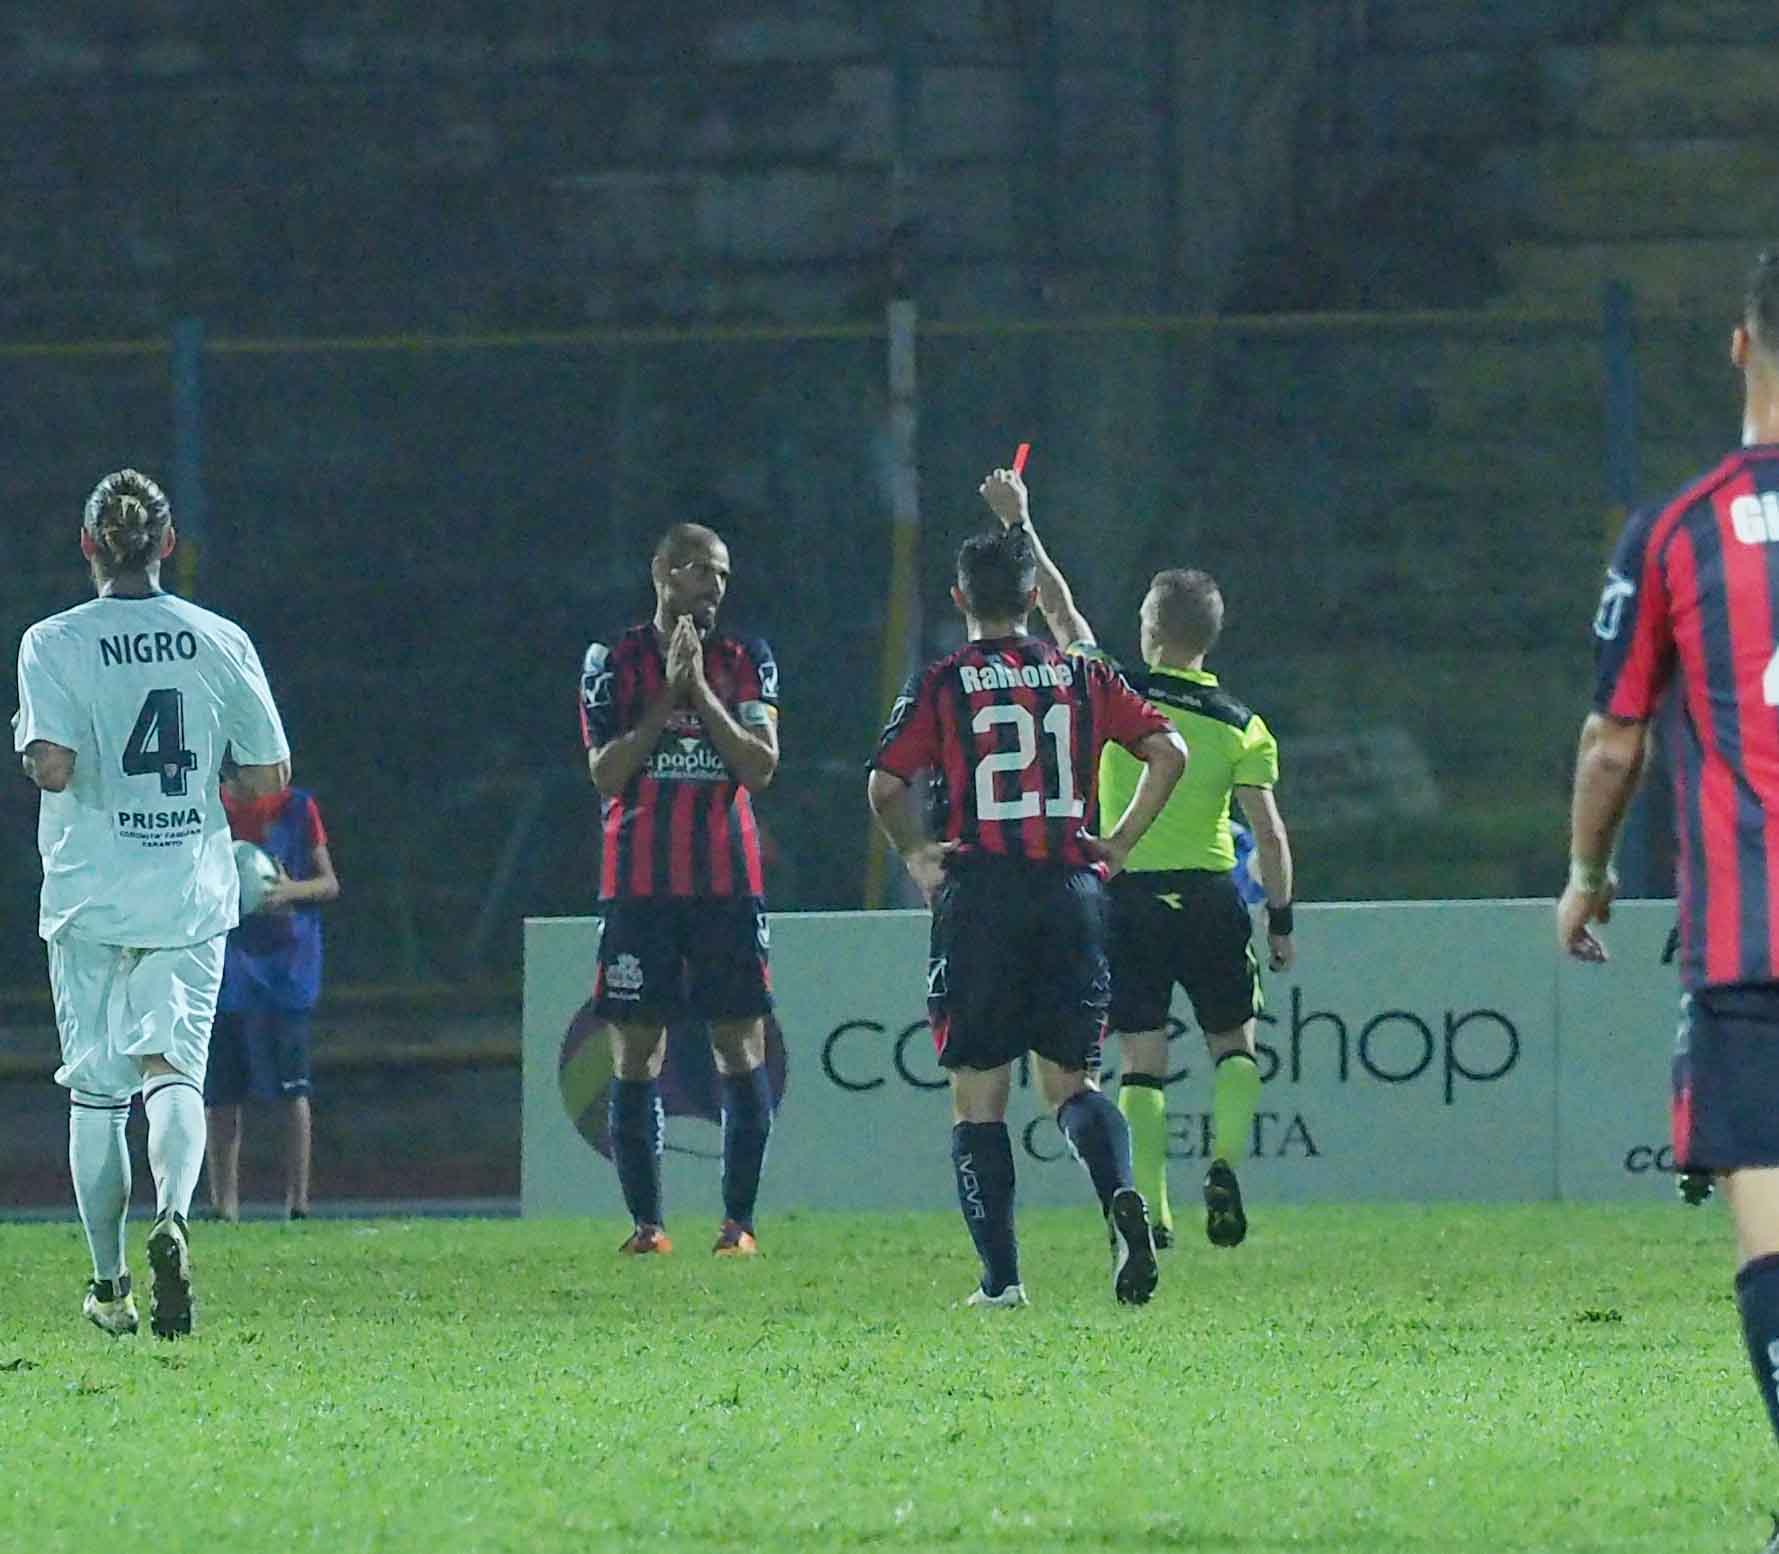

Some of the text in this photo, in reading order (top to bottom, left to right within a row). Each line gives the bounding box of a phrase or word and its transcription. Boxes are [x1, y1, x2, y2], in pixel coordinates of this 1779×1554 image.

[100, 631, 198, 666] NIGRO
[122, 688, 198, 797] 4
[971, 703, 1084, 820] 21
[118, 808, 201, 829] PRISMA
[1248, 986, 1520, 1105] shop
